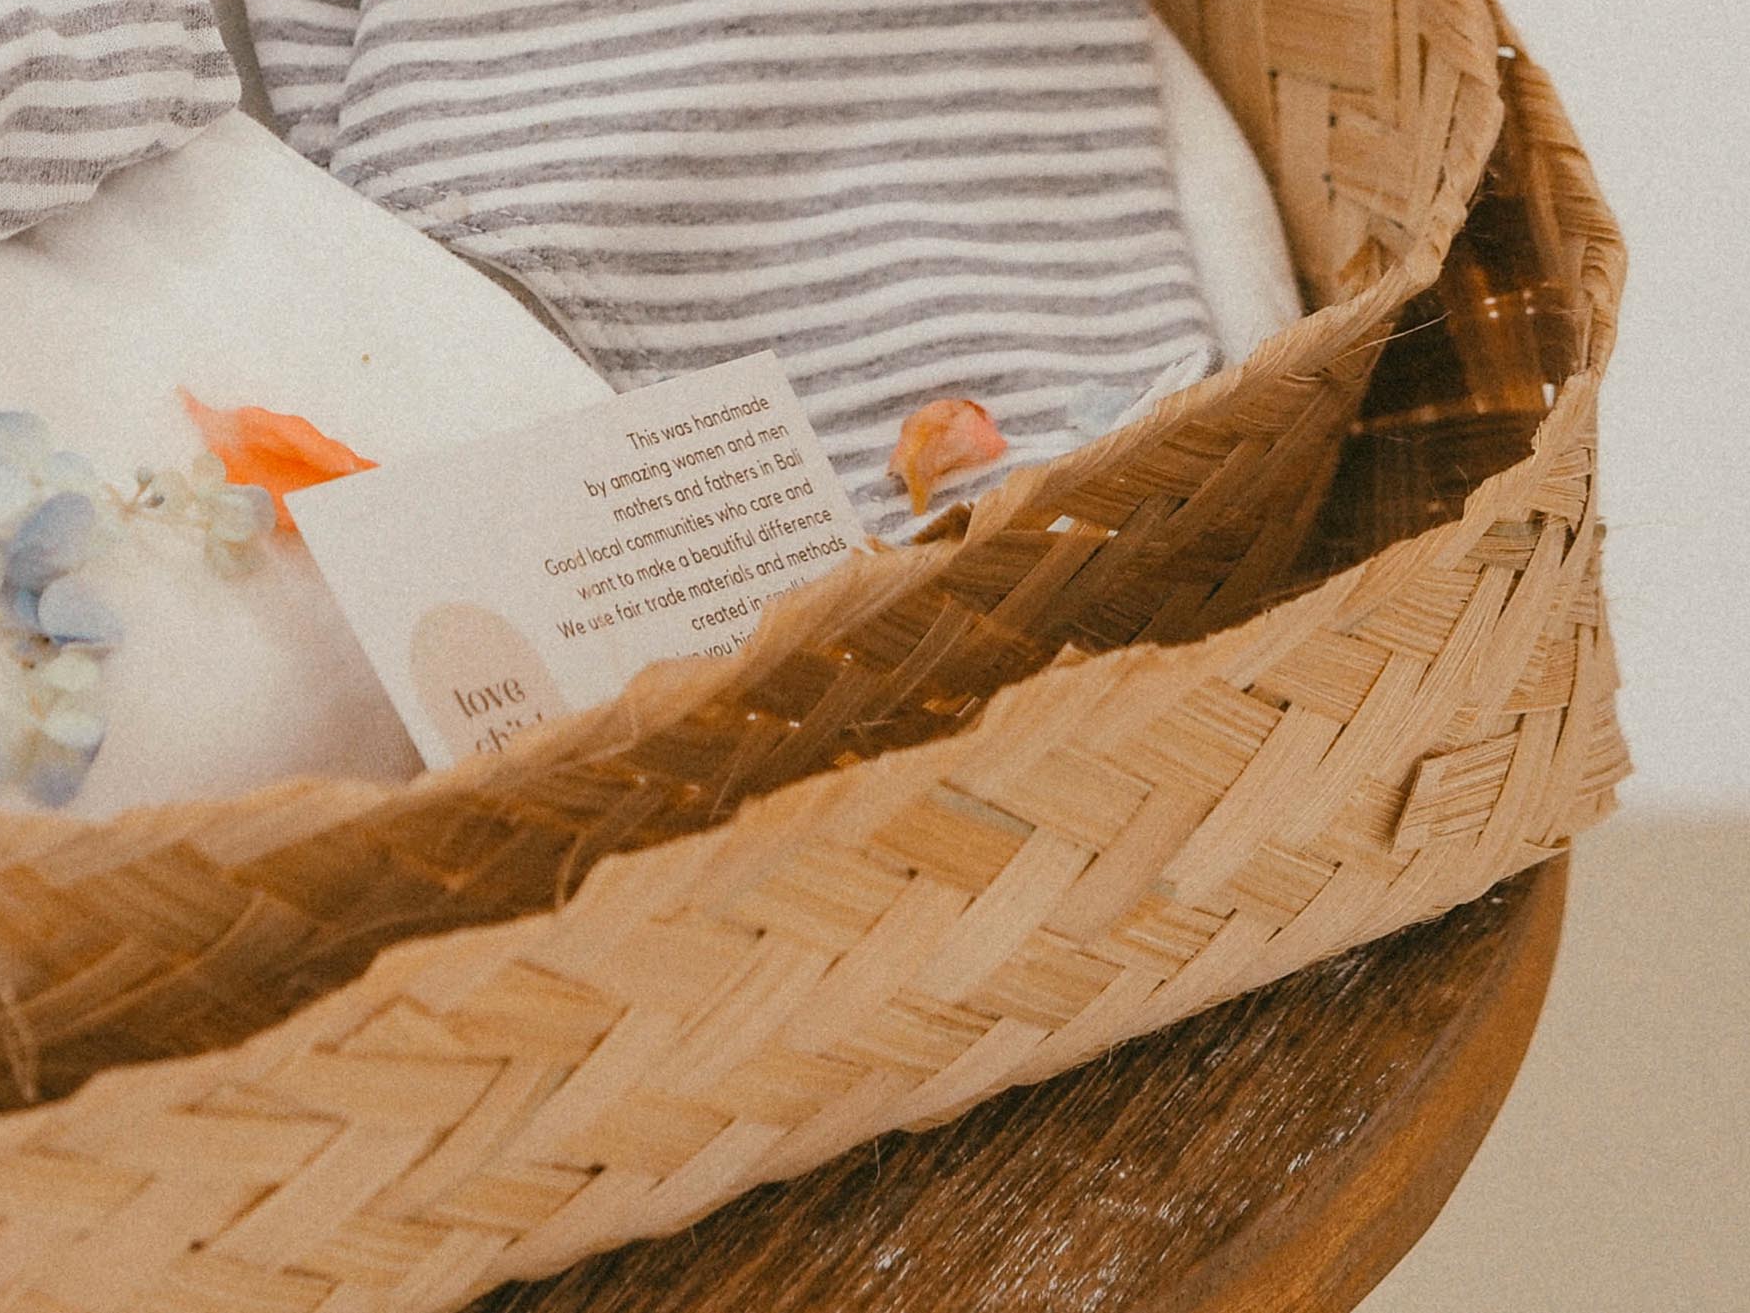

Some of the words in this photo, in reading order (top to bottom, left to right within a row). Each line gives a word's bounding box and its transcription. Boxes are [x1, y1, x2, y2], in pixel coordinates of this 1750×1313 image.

[626, 429, 660, 450] This
[661, 422, 692, 440] was
[691, 395, 771, 431] handmade
[584, 480, 607, 498] by
[610, 461, 672, 490] amazing
[672, 443, 725, 470] women
[727, 429, 756, 453] and
[757, 424, 789, 444] men
[613, 494, 673, 522] mothers
[674, 480, 703, 503] and
[704, 467, 759, 493] fathers
[756, 459, 774, 476] in
[773, 447, 804, 471] Bali
[544, 549, 587, 576] Good
[586, 537, 624, 564] local
[626, 514, 714, 551] communities
[715, 502, 748, 523] who
[750, 492, 783, 512] care
[785, 477, 814, 500] and
[576, 578, 617, 600] want
[616, 572, 635, 588] to
[636, 558, 677, 582] make
[678, 555, 690, 568] a
[688, 529, 757, 564] beautiful
[758, 509, 832, 543] difference
[556, 619, 586, 639] We
[588, 613, 615, 630] use
[615, 601, 642, 621] fair
[644, 587, 687, 613] trade
[688, 565, 754, 599] materials
[756, 552, 785, 576] and
[786, 535, 848, 567] methods
[691, 598, 748, 630] created
[747, 596, 763, 612] in
[704, 641, 733, 658] you
